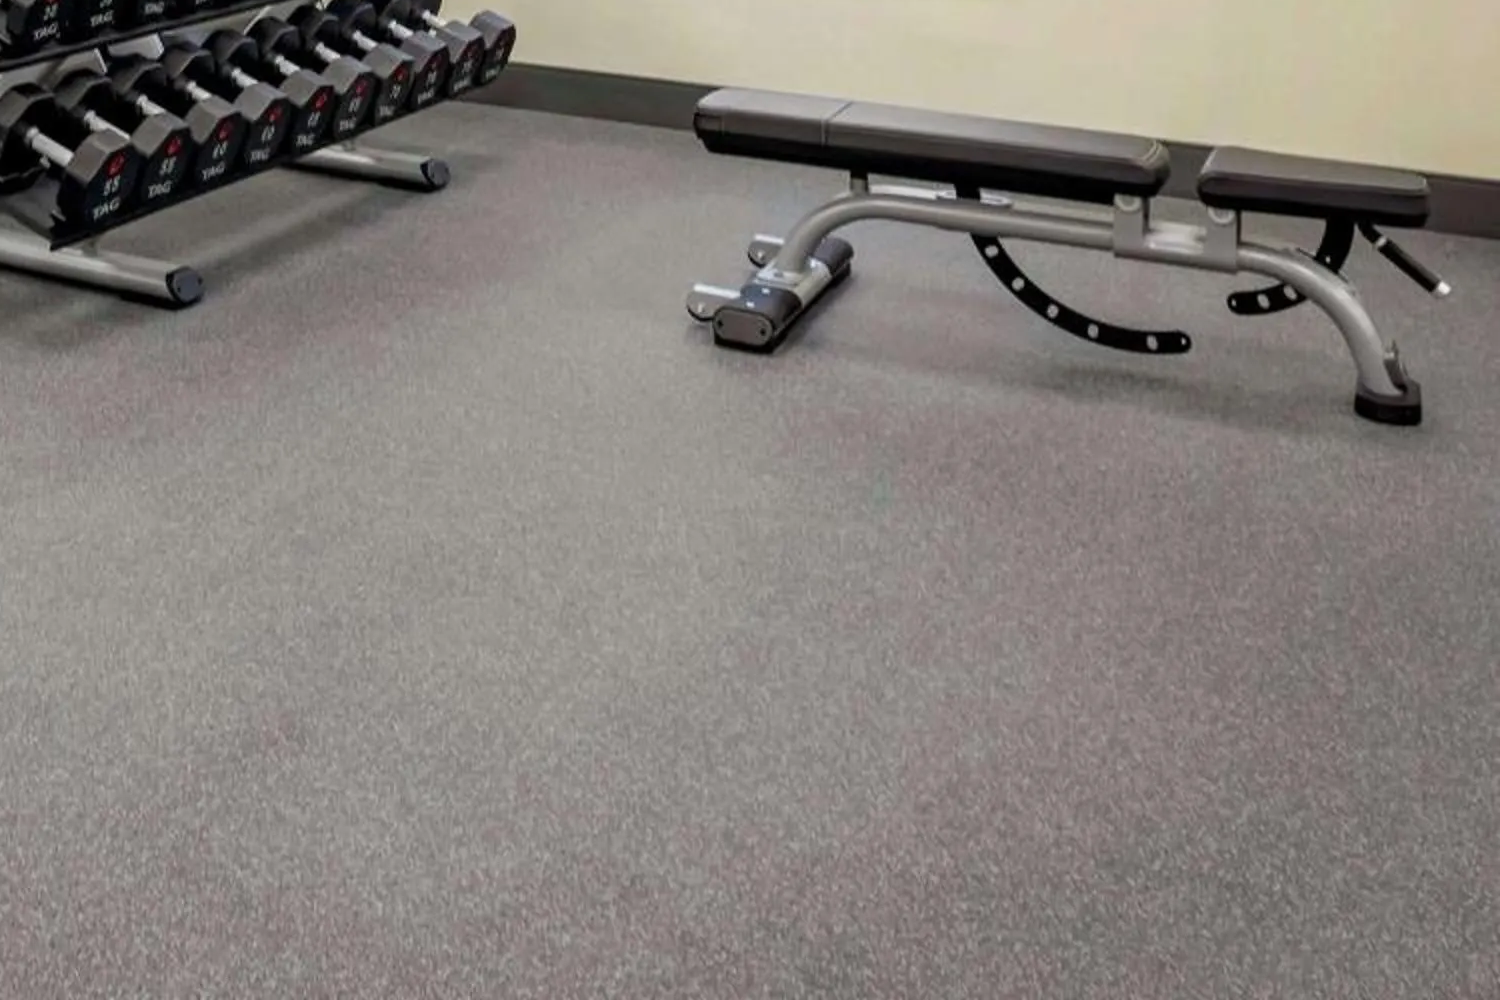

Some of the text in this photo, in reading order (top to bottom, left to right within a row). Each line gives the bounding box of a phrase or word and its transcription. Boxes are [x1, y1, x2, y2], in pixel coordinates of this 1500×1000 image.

[89, 13, 115, 28] TAG
[201, 160, 226, 181] TAG
[147, 180, 173, 199] TAG
[92, 197, 120, 221] TAG
